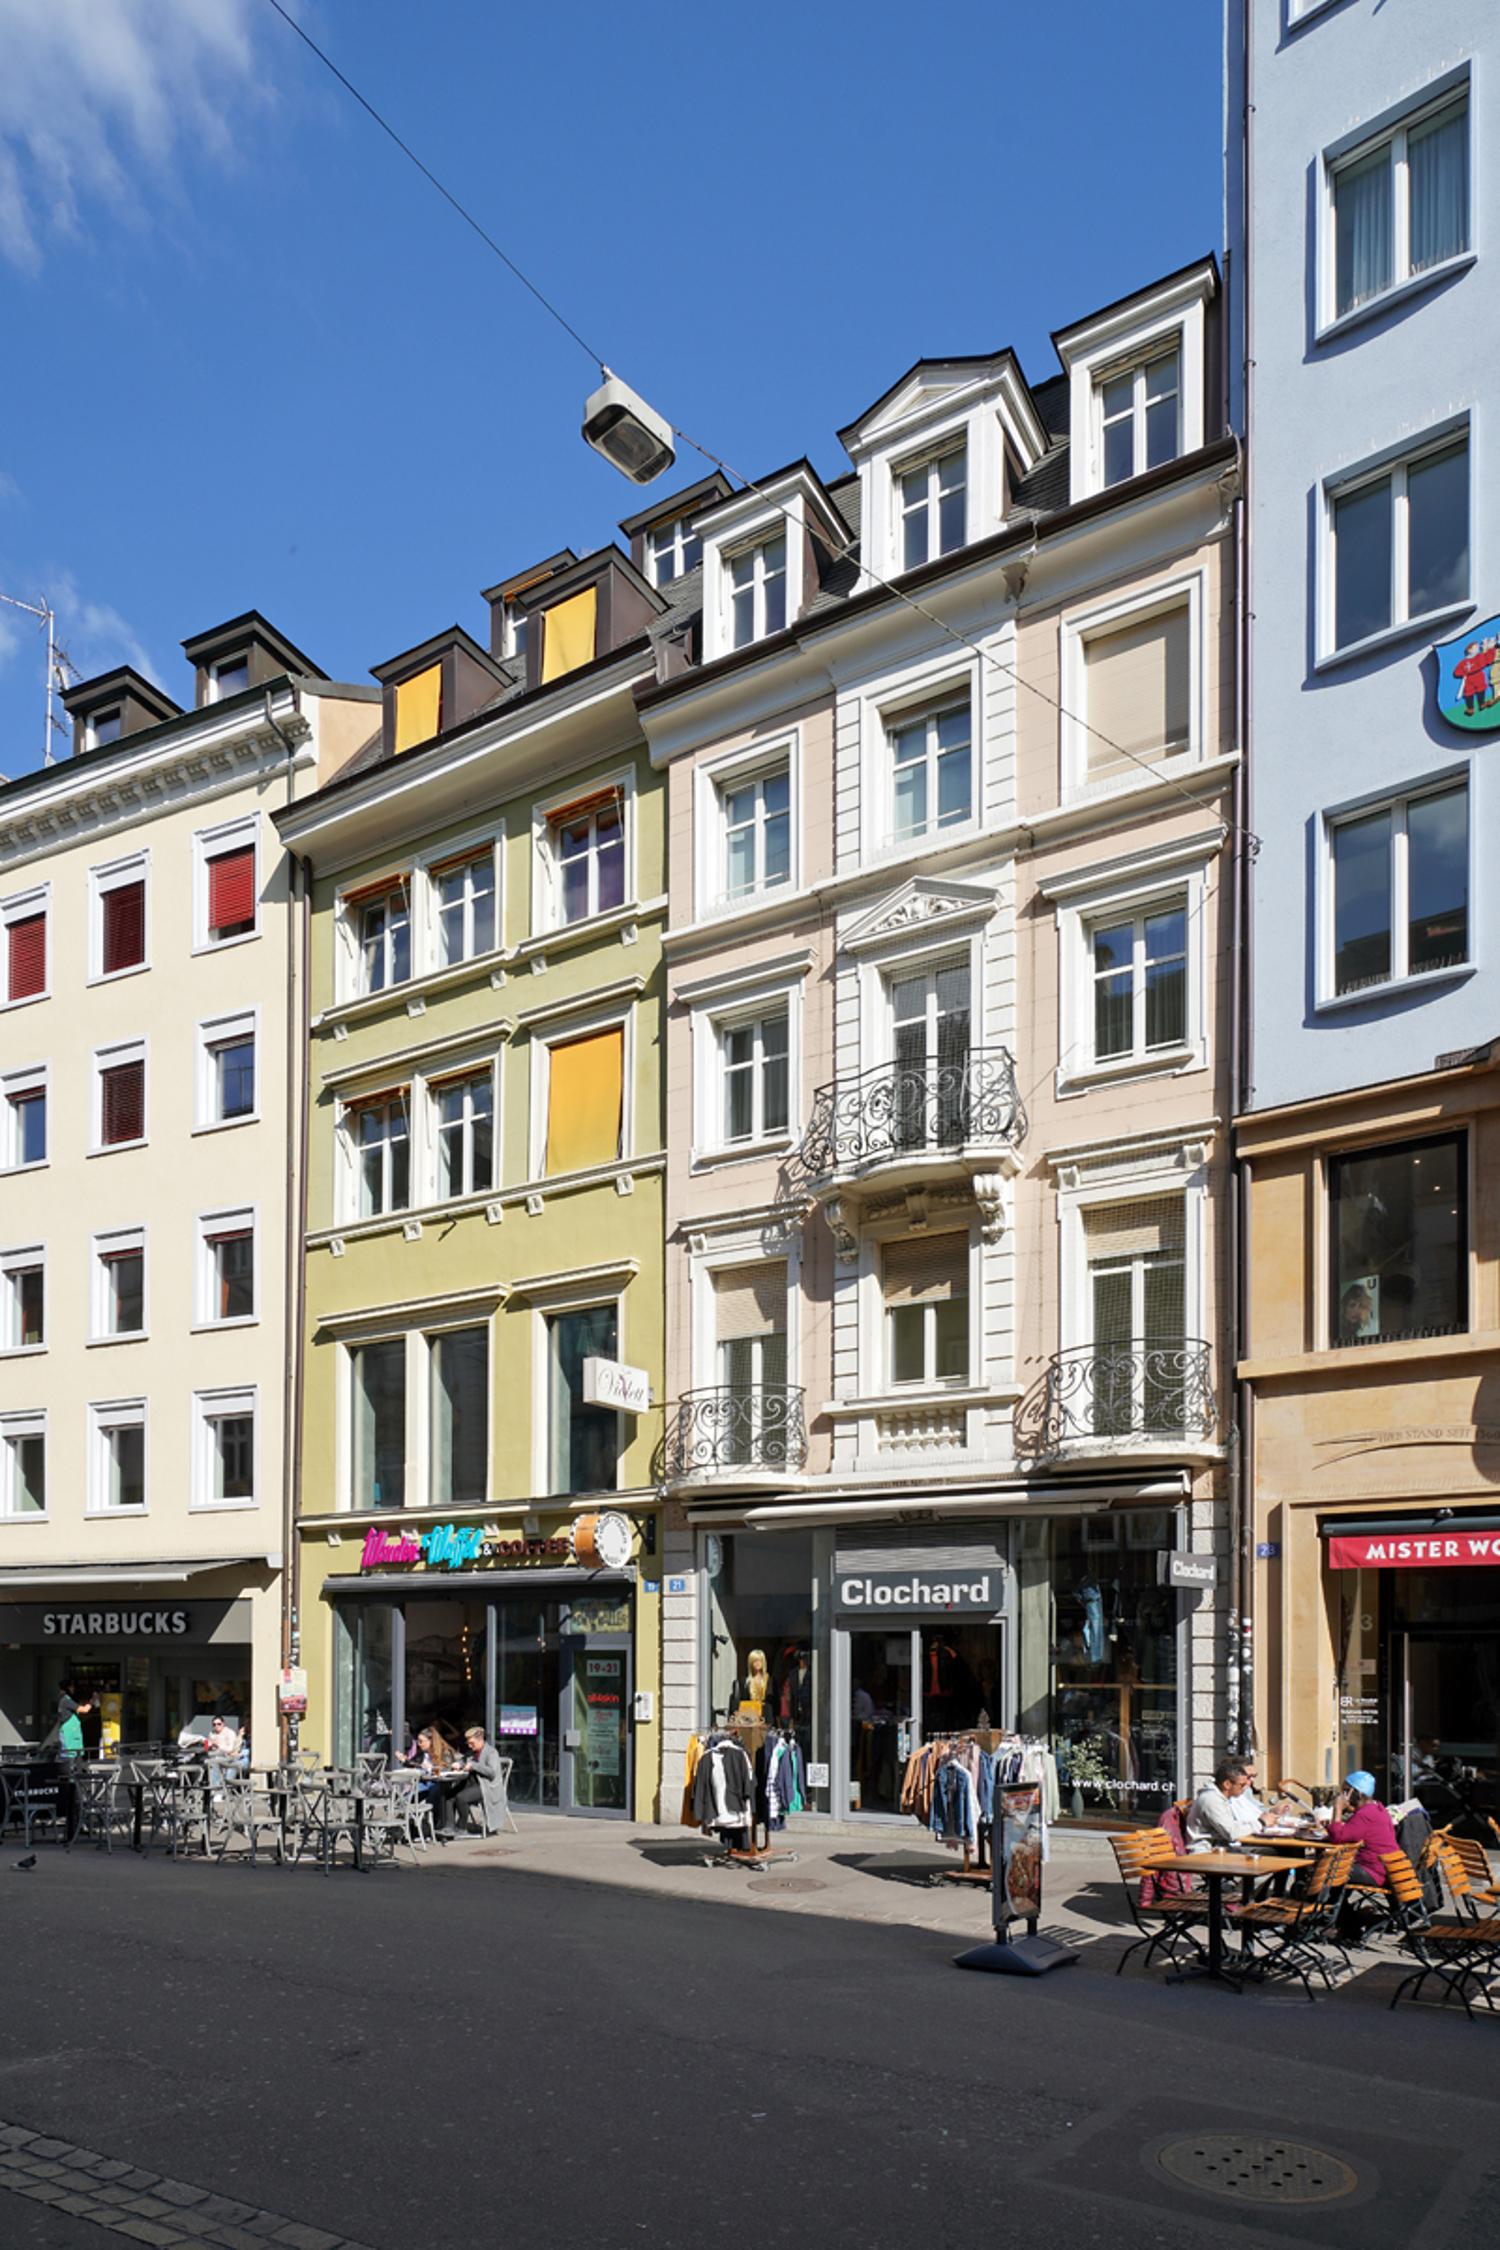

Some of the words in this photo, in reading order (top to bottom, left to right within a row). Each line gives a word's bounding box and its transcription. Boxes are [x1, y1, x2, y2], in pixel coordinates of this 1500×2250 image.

[1406, 1428, 1443, 1439] STAND
[1365, 1540, 1460, 1560] MISTER
[841, 1576, 990, 1606] Clochard
[43, 1611, 187, 1635] STARBUCKS
